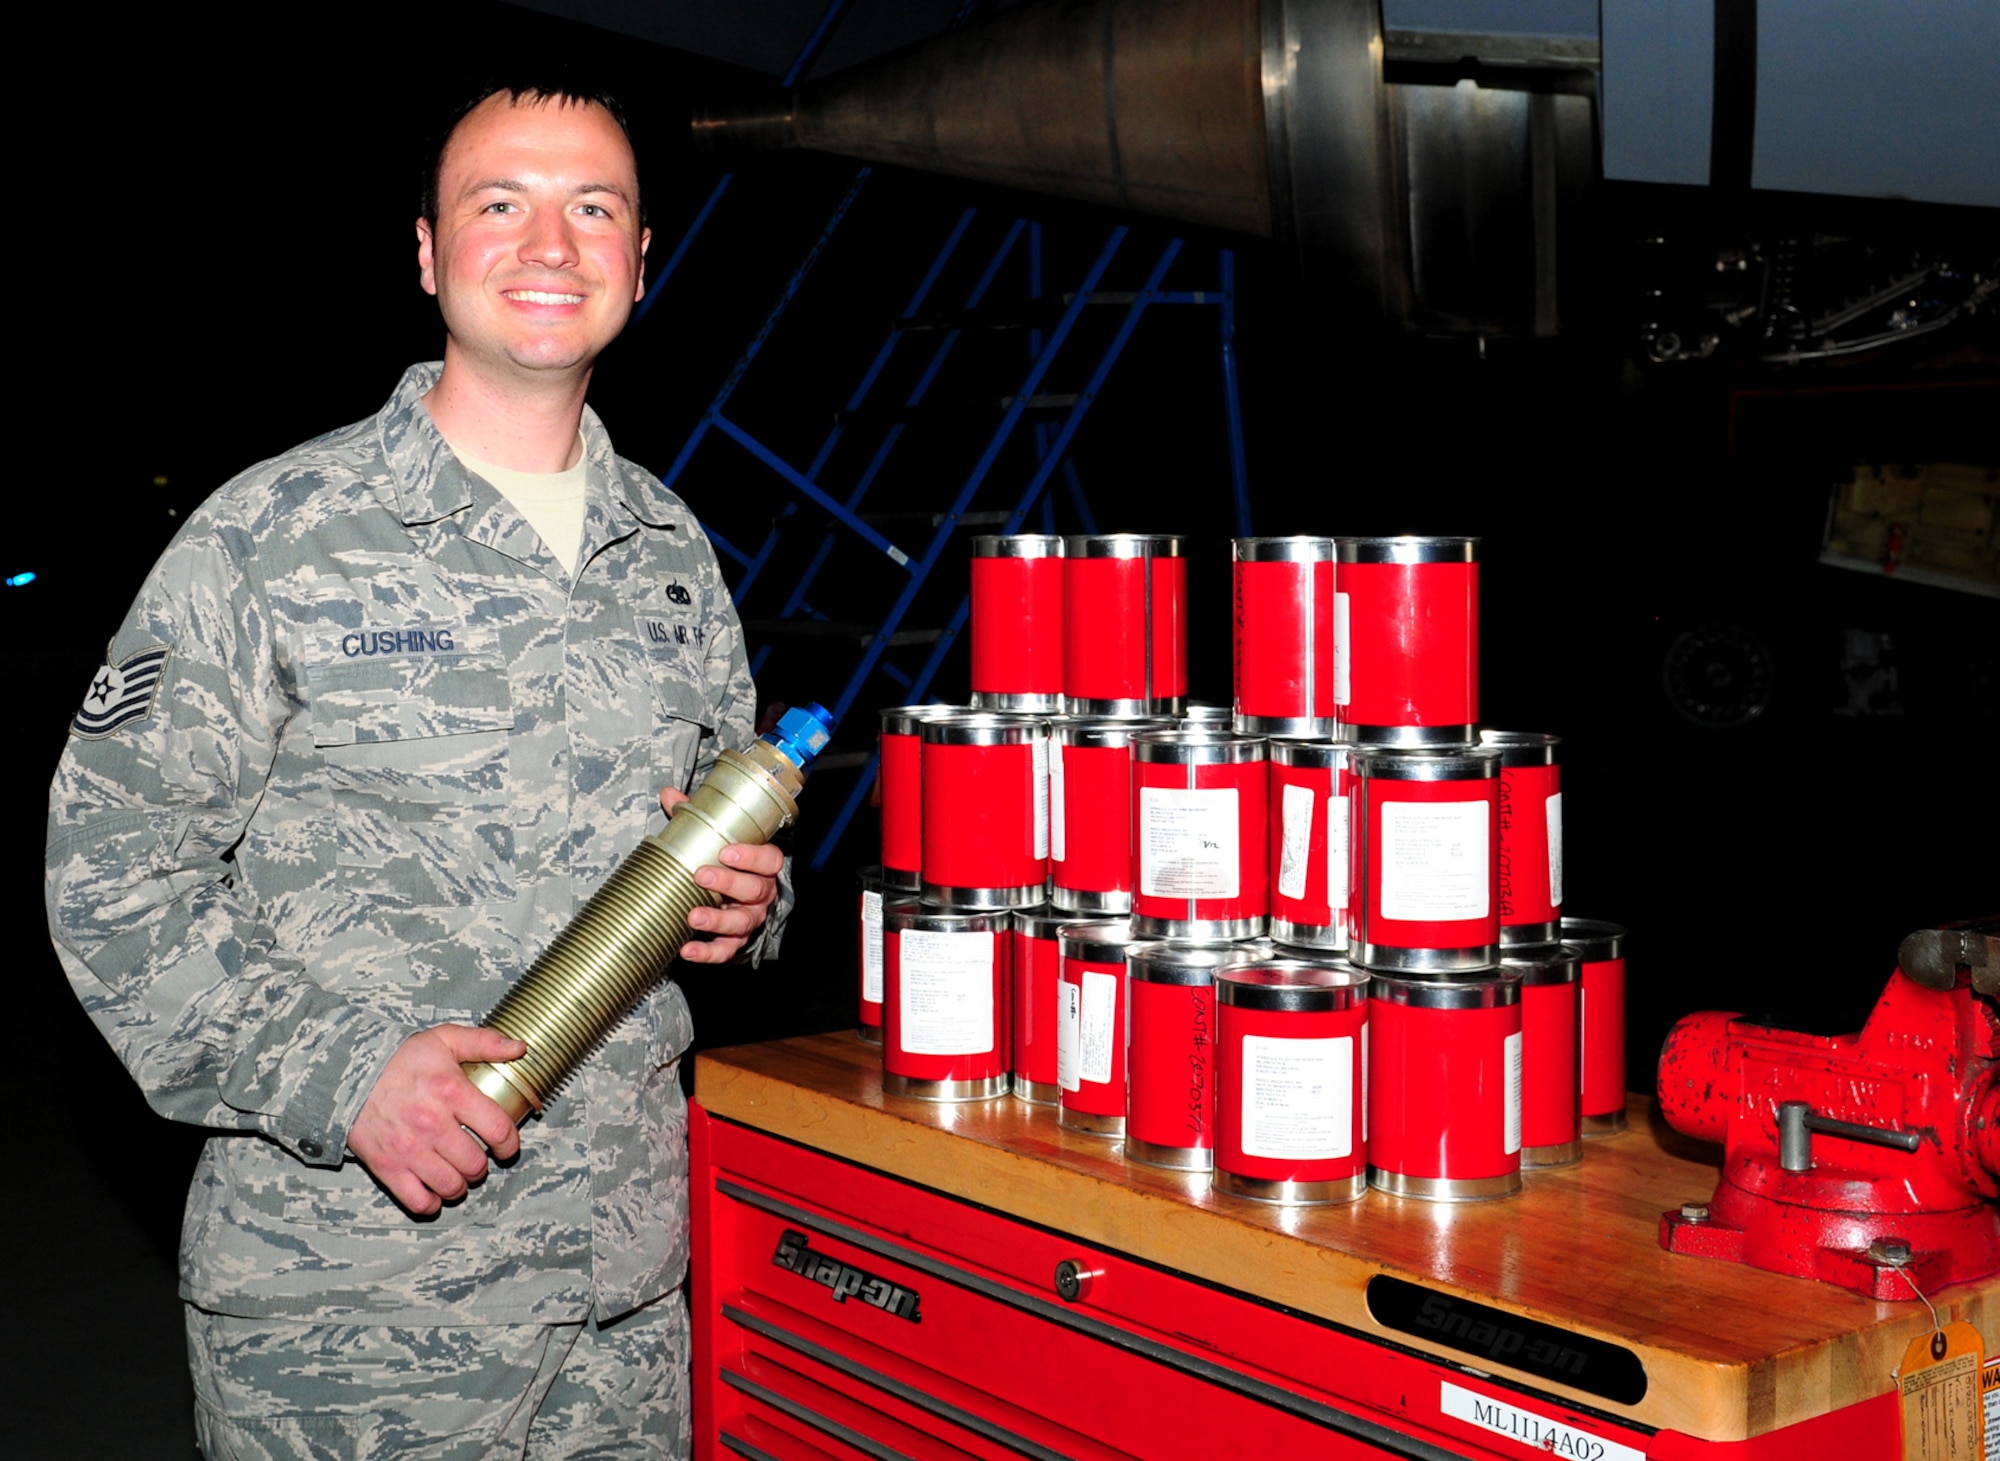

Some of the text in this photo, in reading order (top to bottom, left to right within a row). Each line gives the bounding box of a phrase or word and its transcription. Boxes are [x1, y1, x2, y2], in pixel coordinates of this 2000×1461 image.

[342, 630, 454, 657] CUSHING
[772, 1229, 920, 1321] Snap-on
[1414, 1294, 1589, 1376] Snap-on
